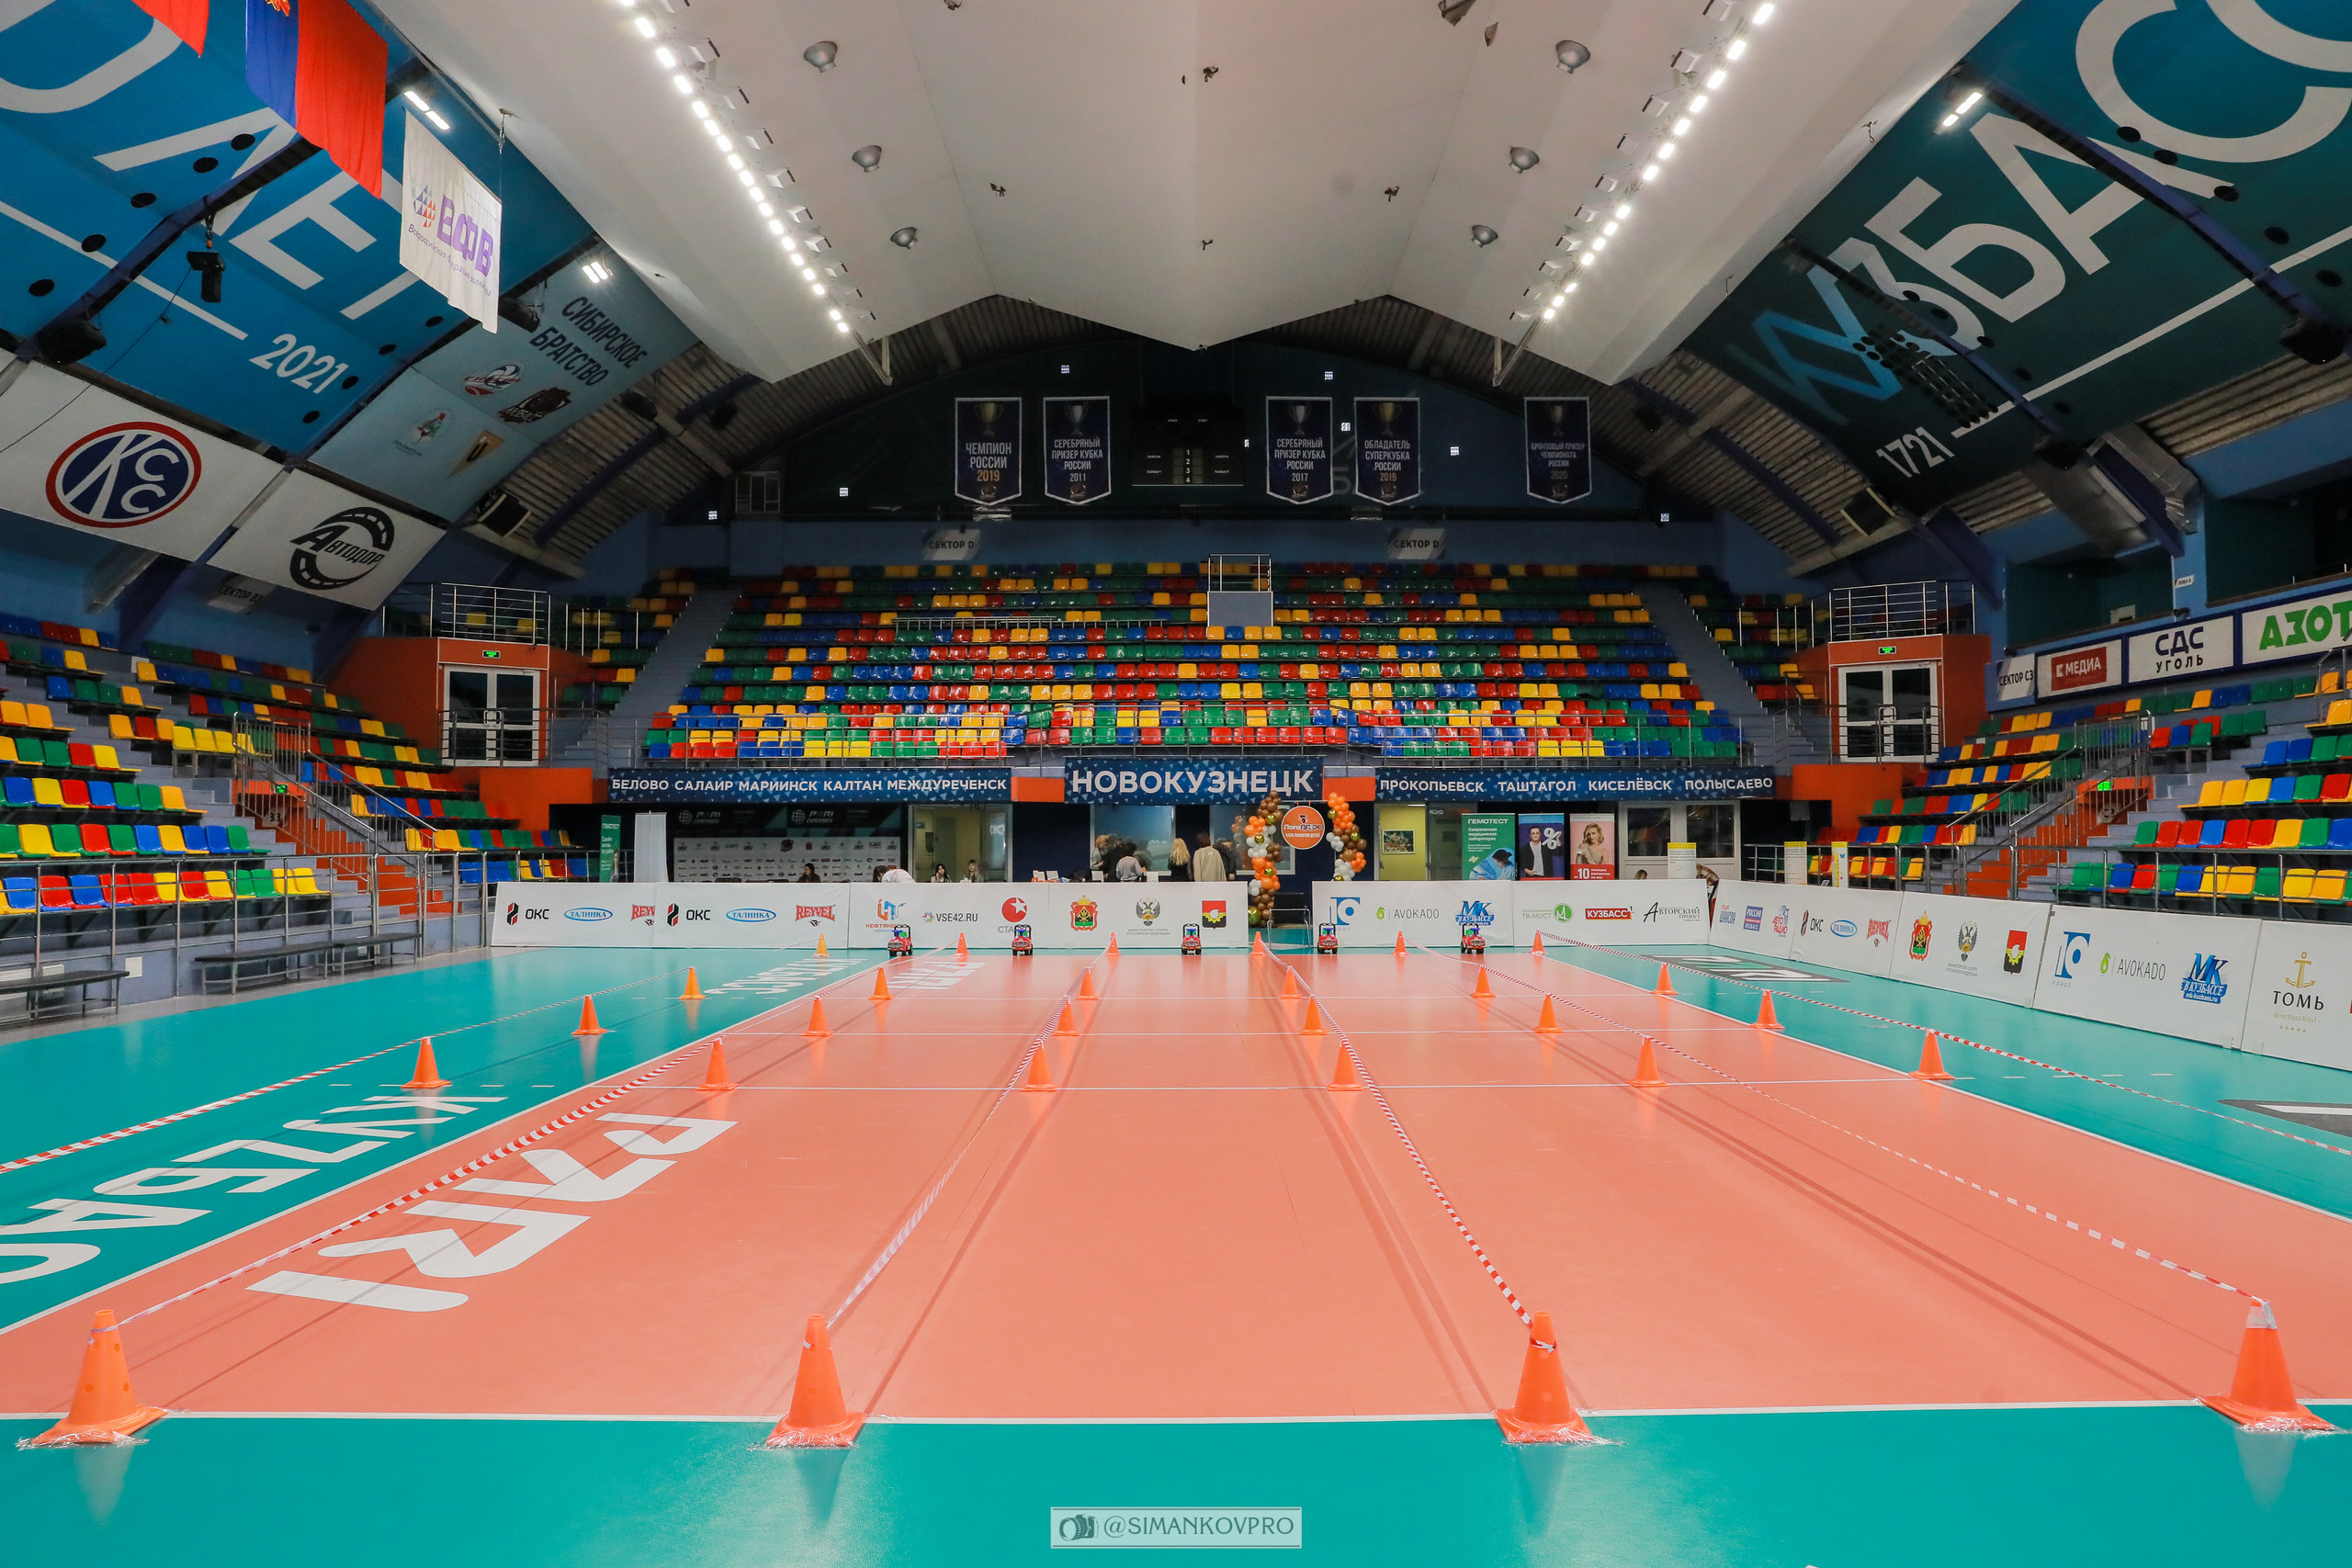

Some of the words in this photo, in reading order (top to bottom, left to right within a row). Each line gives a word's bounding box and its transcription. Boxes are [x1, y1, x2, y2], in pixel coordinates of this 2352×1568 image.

[436, 195, 493, 277] ВФВ
[562, 296, 649, 369] СИБИРСКОЕ
[529, 326, 609, 387] БРАТСТВО
[250, 334, 349, 395] 2021
[1054, 437, 1101, 448] СЕРЕБРЯНЫЙ
[1276, 437, 1323, 448] СЕРЕБРЯНЫЙ
[1364, 440, 1411, 450] ОБЛАДАТЕЛЬ
[1531, 442, 1564, 451] БРОНЗОВЫЙ
[1566, 443, 1585, 451] ПРИЗЕР
[966, 442, 1012, 455] ЧЕМПИОН
[1051, 450, 1079, 459] ПРИЗЕР
[1080, 449, 1103, 458] КУБКА
[1274, 450, 1301, 459] ПРИЗЕР
[1302, 449, 1326, 458] КУБКА
[1876, 426, 1954, 479] 1721
[1365, 451, 1410, 460] СУПЕРКУБКА
[1541, 451, 1577, 459] ЧЕМПИОНАТА
[970, 457, 1007, 468] РОССИИ
[1064, 460, 1091, 470] РОССИИ
[1286, 460, 1314, 470] РОССИИ
[1374, 462, 1402, 471] РОССИИ
[977, 469, 1001, 482] 2019
[1069, 473, 1086, 482] 2011
[1292, 473, 1308, 482] 2017
[1380, 472, 1396, 481] 2019
[1551, 470, 1568, 479] 2020
[290, 525, 386, 566] АВТОДОР
[929, 540, 966, 550] СЕКТОР
[967, 540, 975, 549] D
[1395, 539, 1430, 549] СЕКТОР
[1431, 538, 1440, 548] D
[218, 585, 251, 600] СЕКТОР
[2155, 626, 2204, 656] СДС
[2064, 656, 2101, 677] МЕДИА
[2155, 654, 2204, 674] УГОЛЬ
[1998, 671, 2024, 687] СЕКТОР
[612, 779, 669, 791] БЕЛОВО
[674, 780, 733, 791] САЛАИР
[739, 780, 818, 792] МАРИИНСК
[823, 780, 882, 791] КАЛТАН
[887, 779, 1007, 793] МЕЖДУРЕЧЕНСК
[1072, 770, 1314, 796] НОВОКУЗНЕЦК
[1380, 779, 1485, 793] ПРОКОПЬЕВСК
[1498, 781, 1577, 792] ТАШТАГОЛ
[1589, 778, 1672, 791] КИСЕЛЁВСК
[1685, 777, 1773, 791] ПОЛЫСАЕВО
[1577, 868, 1590, 880] 10
[526, 908, 549, 919] ОКС
[795, 905, 835, 922] REYVEL
[1394, 908, 1440, 919] AVOKADO
[1461, 900, 1492, 917] МК
[1587, 909, 1629, 918] КУЗБАСС
[686, 909, 710, 920] ОКС
[936, 913, 978, 922] VSE42.RU
[2117, 958, 2166, 981] AVOKADO
[2188, 953, 2229, 985] МК
[2188, 982, 2224, 995] КУЗБАССЕ
[2273, 990, 2325, 1011] ТОМЬ
[2301, 1015, 2316, 1023] Hotel
